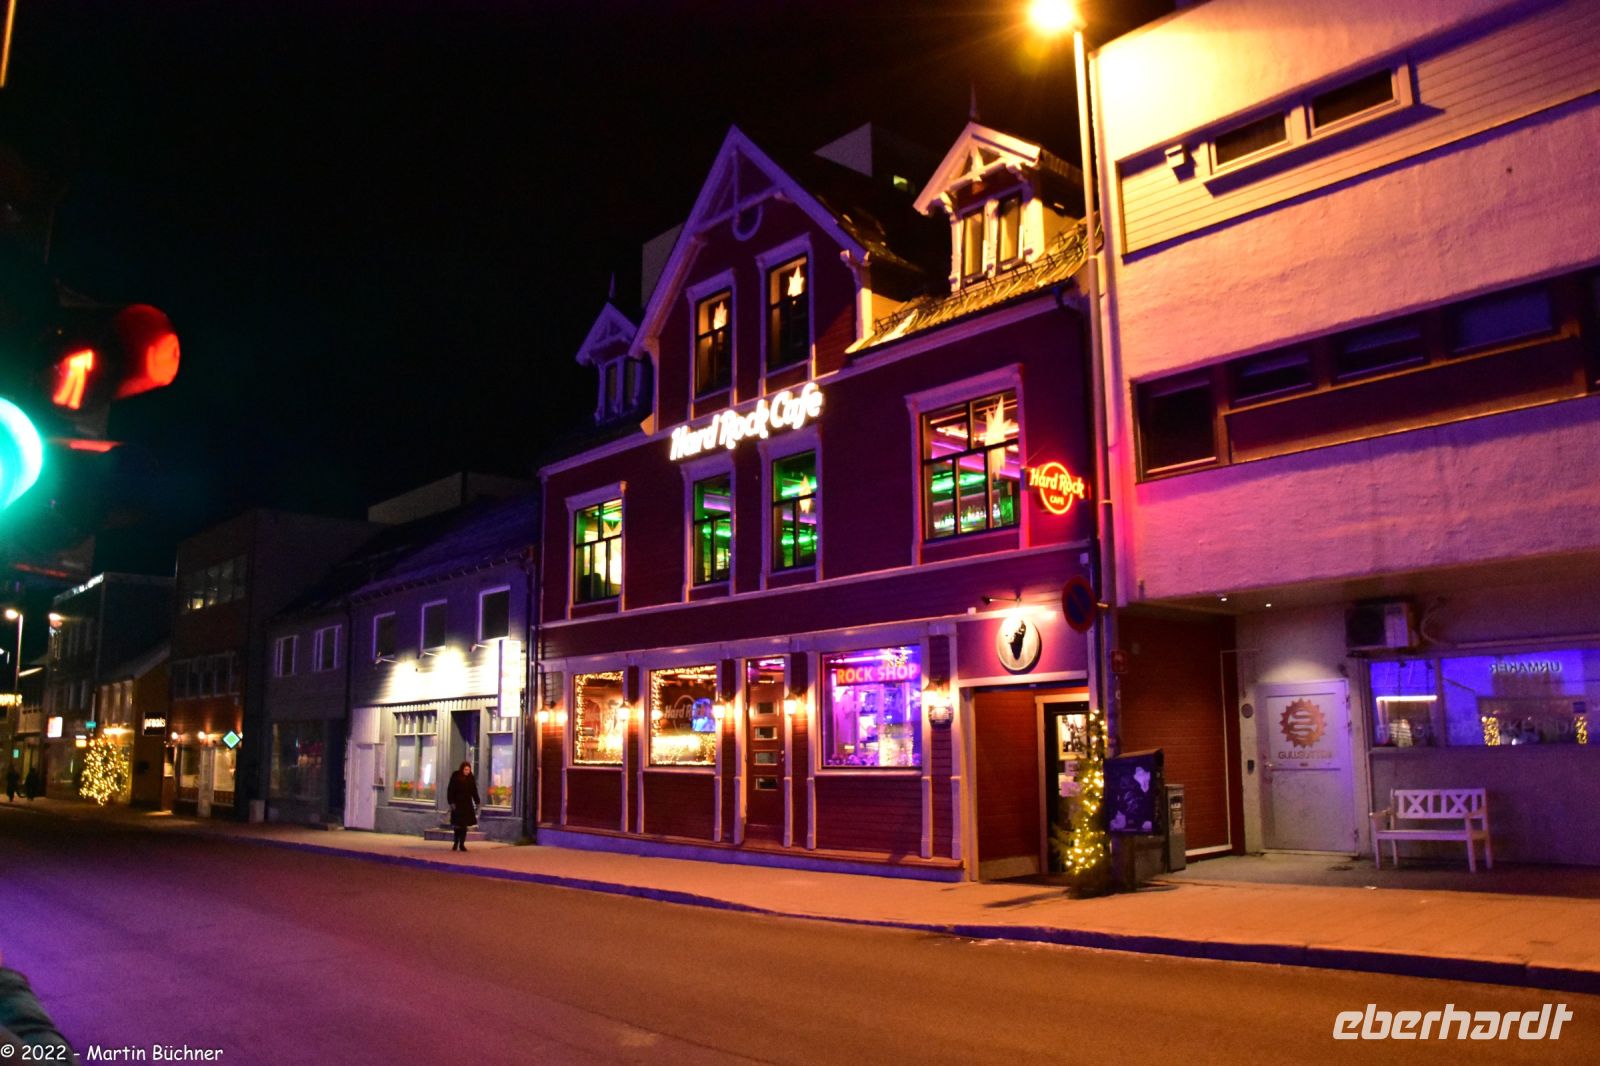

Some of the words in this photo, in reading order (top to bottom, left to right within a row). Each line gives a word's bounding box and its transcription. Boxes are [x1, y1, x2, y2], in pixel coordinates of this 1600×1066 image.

[669, 414, 720, 461] Hard
[719, 399, 769, 450] Rock
[770, 382, 824, 430] Cafe
[1029, 468, 1058, 490] Hard
[1059, 473, 1085, 499] Rock
[1050, 495, 1065, 505] CAFE
[837, 667, 873, 684] ROCK
[878, 663, 918, 681] SHOP
[664, 703, 686, 719] Hard
